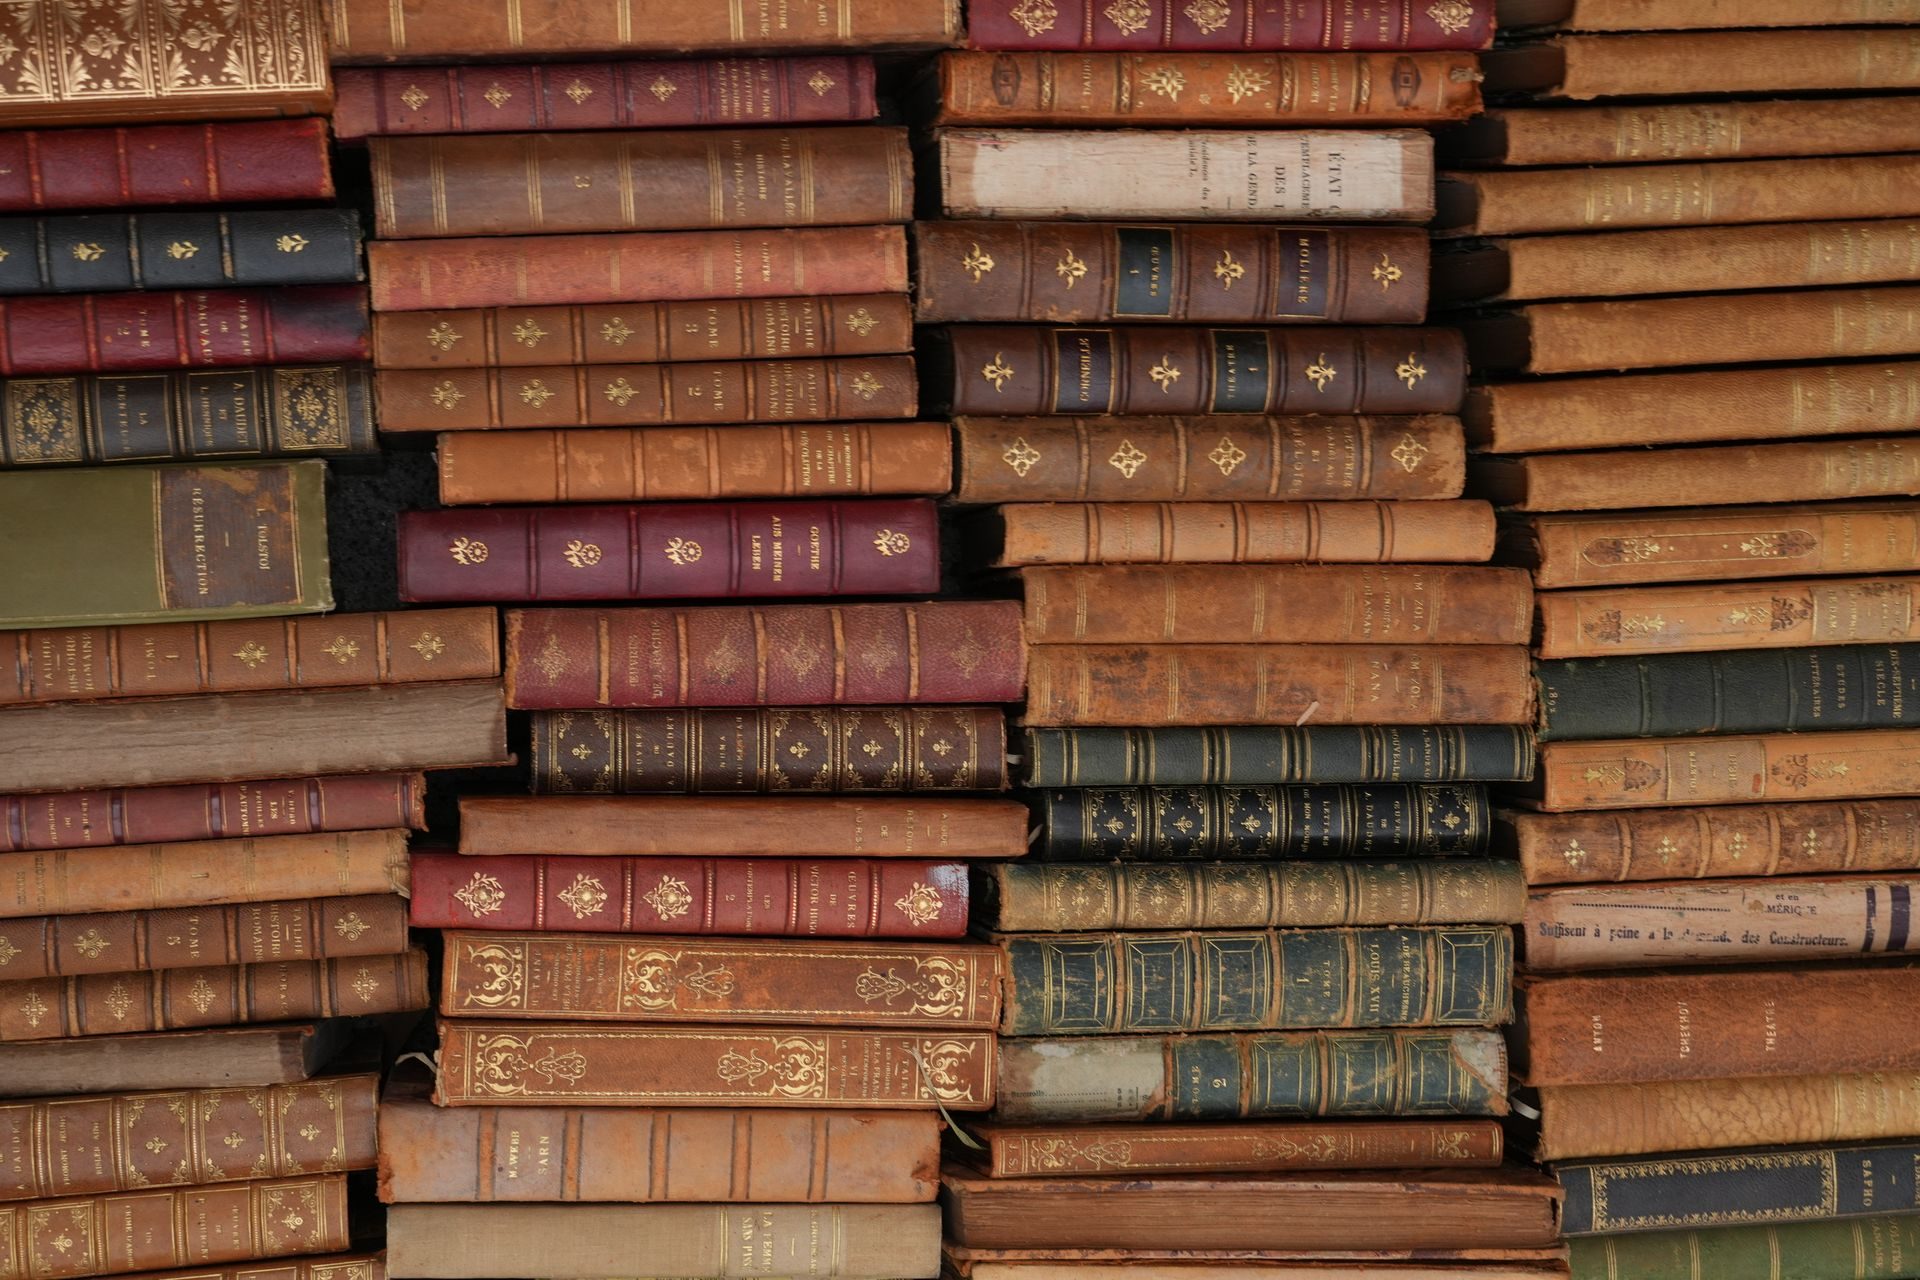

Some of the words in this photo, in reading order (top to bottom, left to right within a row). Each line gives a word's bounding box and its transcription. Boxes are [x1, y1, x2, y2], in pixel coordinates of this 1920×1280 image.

[1342, 20, 1354, 50] HUGO
[1247, 152, 1257, 166] LA
[1327, 152, 1346, 197] ÉTAT
[574, 175, 592, 188] 3
[755, 153, 768, 201] HISTOIRE
[1201, 186, 1211, 200] des
[1274, 166, 1286, 195] DES
[757, 241, 771, 283] CONTES
[1149, 246, 1160, 297] ŒUVRES
[139, 309, 150, 348] TOME
[197, 295, 214, 365] MARIVAUX
[220, 320, 230, 333] DE
[685, 323, 699, 333] 3
[708, 307, 719, 349] TOME
[763, 301, 777, 355] ROMAINE
[777, 301, 791, 353] HISTOIRE
[1078, 337, 1092, 402] CORNEILLE
[687, 386, 703, 397] 2
[712, 370, 724, 411] TOME
[767, 363, 780, 418] ROMAINE
[782, 363, 794, 417] HISTOIRE
[138, 411, 149, 426] LA
[217, 408, 228, 422] ET
[232, 396, 250, 446] DAUDET
[815, 461, 824, 471] LA
[827, 445, 836, 485] CHAPITRE
[1311, 449, 1321, 463] ET
[1341, 426, 1354, 488] LETTRES
[256, 508, 267, 517] L.
[771, 515, 783, 538] AUS
[192, 487, 209, 596] RÉSURRECTION
[751, 535, 762, 571] LEBEN
[808, 526, 821, 570] GOETHE
[771, 541, 782, 582] MEINEM
[1412, 599, 1424, 633] ZOLA
[144, 637, 157, 681] TOME
[650, 619, 664, 666] RACINE
[65, 635, 80, 694] HISTOIRE
[81, 631, 96, 691] ROMAINE
[651, 683, 664, 699] DE
[1369, 660, 1382, 704] NANA
[1409, 678, 1421, 712] ZOLA
[653, 743, 661, 755] DE
[665, 714, 675, 768] DAUDET
[1421, 728, 1430, 736] J.
[634, 725, 645, 777] ŒUVRES
[718, 735, 728, 769] NUMA
[1390, 728, 1402, 783] NOUVELLES
[254, 789, 265, 828] FEUILLES
[269, 801, 279, 820] LES
[1302, 788, 1311, 799] DE
[1364, 791, 1372, 801] A.
[63, 816, 73, 828] DU
[287, 800, 297, 825] HUGO
[1303, 802, 1311, 820] MON
[1322, 800, 1331, 847] LETTRES
[1363, 804, 1375, 852] DAUDET
[1379, 818, 1388, 829] DE
[1392, 800, 1401, 845] ŒUVRES
[879, 824, 889, 838] DE
[904, 809, 914, 853] RETOUR
[939, 824, 949, 848] GIDE
[1301, 824, 1312, 853] MOULIN
[724, 893, 736, 903] 2
[808, 864, 821, 905] VICTOR
[828, 892, 838, 907] DE
[846, 870, 857, 929] ŒUVRES
[1787, 894, 1800, 902] en
[763, 893, 772, 911] LES
[1763, 903, 1818, 917] MÉRIQE
[188, 915, 200, 959] TOME
[251, 908, 265, 962] ROMAINE
[269, 903, 281, 959] HISTOIRE
[807, 907, 819, 934] HUGO
[1539, 921, 1587, 939] Suffisent
[1593, 923, 1602, 938] à
[1741, 930, 1761, 945] des
[167, 936, 181, 946] 5
[1400, 935, 1410, 944] A.
[1401, 945, 1411, 959] DE
[532, 949, 543, 989] TAINE
[563, 942, 574, 982] FRANCE
[1322, 959, 1331, 999] TOME
[1368, 943, 1381, 982] LOUIS
[562, 984, 571, 997] LA
[1295, 976, 1311, 984] 1
[1400, 960, 1412, 1022] BEAUCHESNE
[1368, 986, 1381, 1013] XVII
[872, 1037, 881, 1049] DE
[1591, 1014, 1604, 1052] ANTON
[1677, 1000, 1691, 1060] TCHEKHOV
[848, 1065, 859, 1077] VI
[872, 1051, 881, 1065] LA
[871, 1066, 881, 1103] FRANCE
[900, 1059, 911, 1098] TAINE
[1191, 1065, 1202, 1105] TOME
[1211, 1077, 1227, 1089] 2
[77, 1145, 86, 1153] &
[92, 1146, 103, 1176] RISLER
[537, 1135, 550, 1176] SARN
[60, 1147, 73, 1186] FROMONT
[1861, 1159, 1873, 1208] SAPHO
[124, 1204, 134, 1233] CRIME
[215, 1224, 222, 1234] DE
[742, 1216, 754, 1241] SANS
[761, 1211, 774, 1229] LA
[760, 1232, 774, 1274] FEMME
